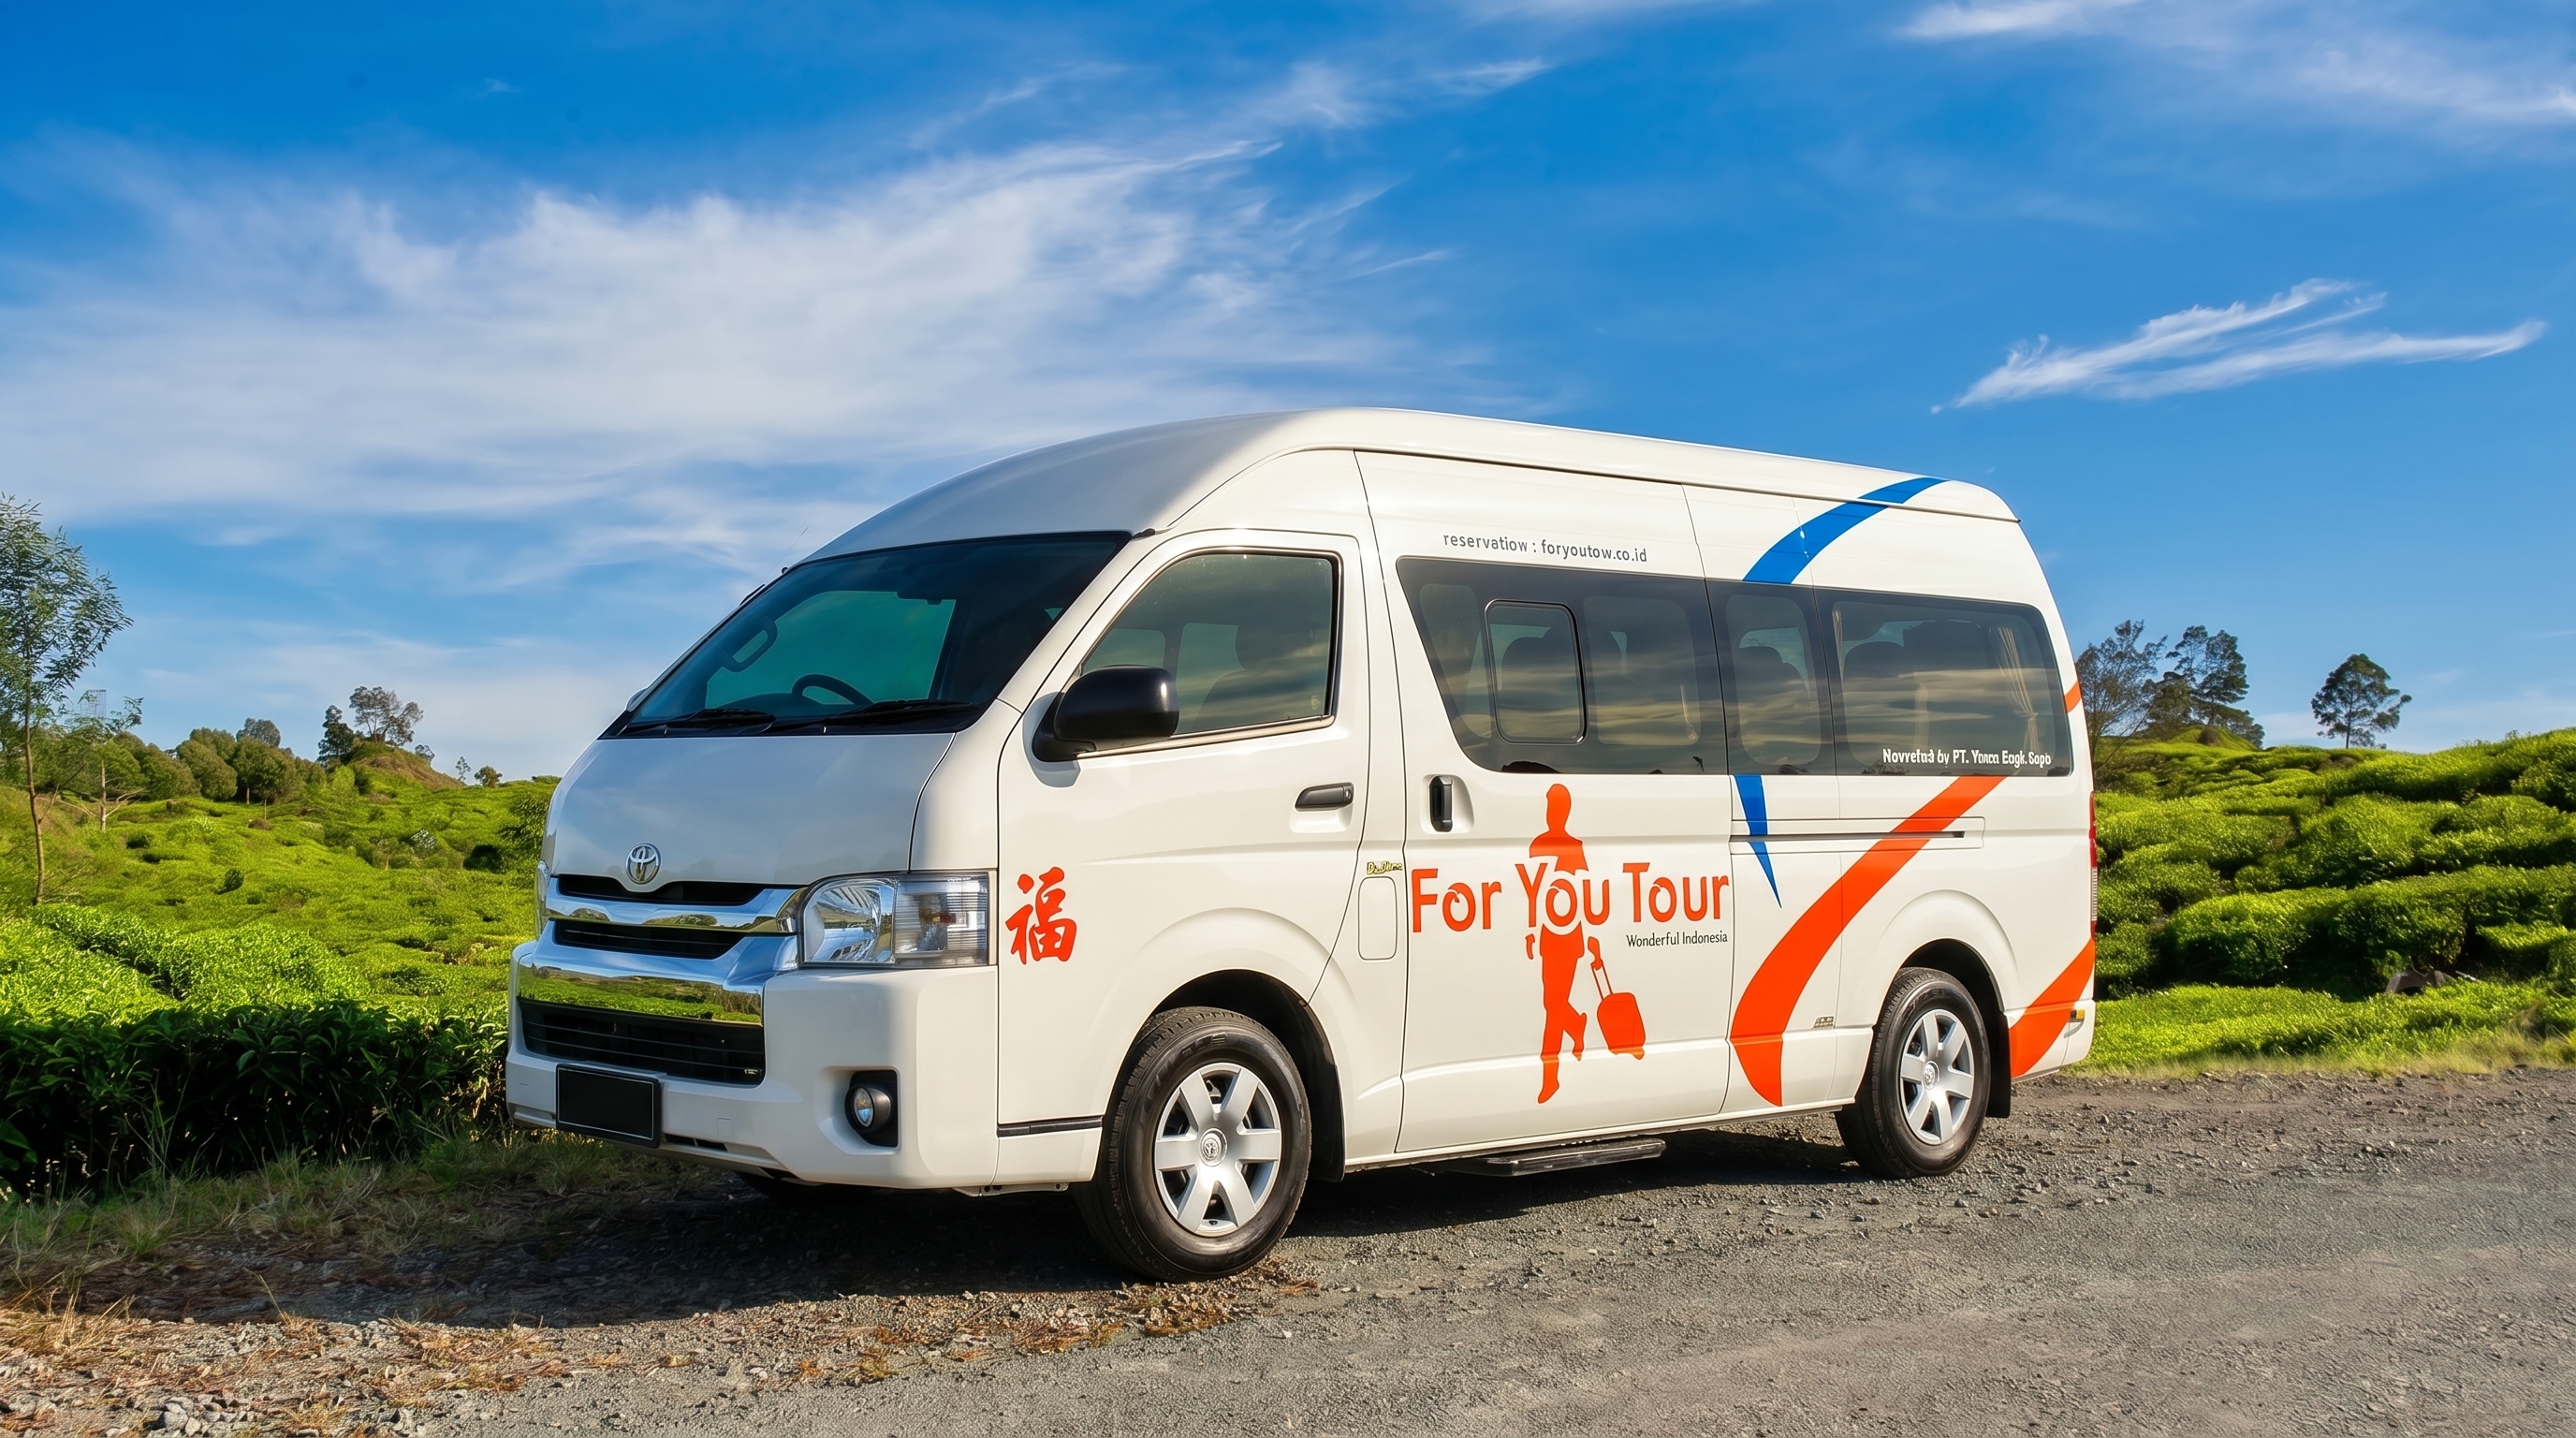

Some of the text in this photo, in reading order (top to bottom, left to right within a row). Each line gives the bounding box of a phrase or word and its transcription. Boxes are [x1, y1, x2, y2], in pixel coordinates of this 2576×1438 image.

[1953, 749, 1969, 764] PT.
[1004, 866, 1077, 965] 福
[1411, 862, 1730, 933] For You Tour
[1625, 930, 1729, 947] Wonderful Indonesia
